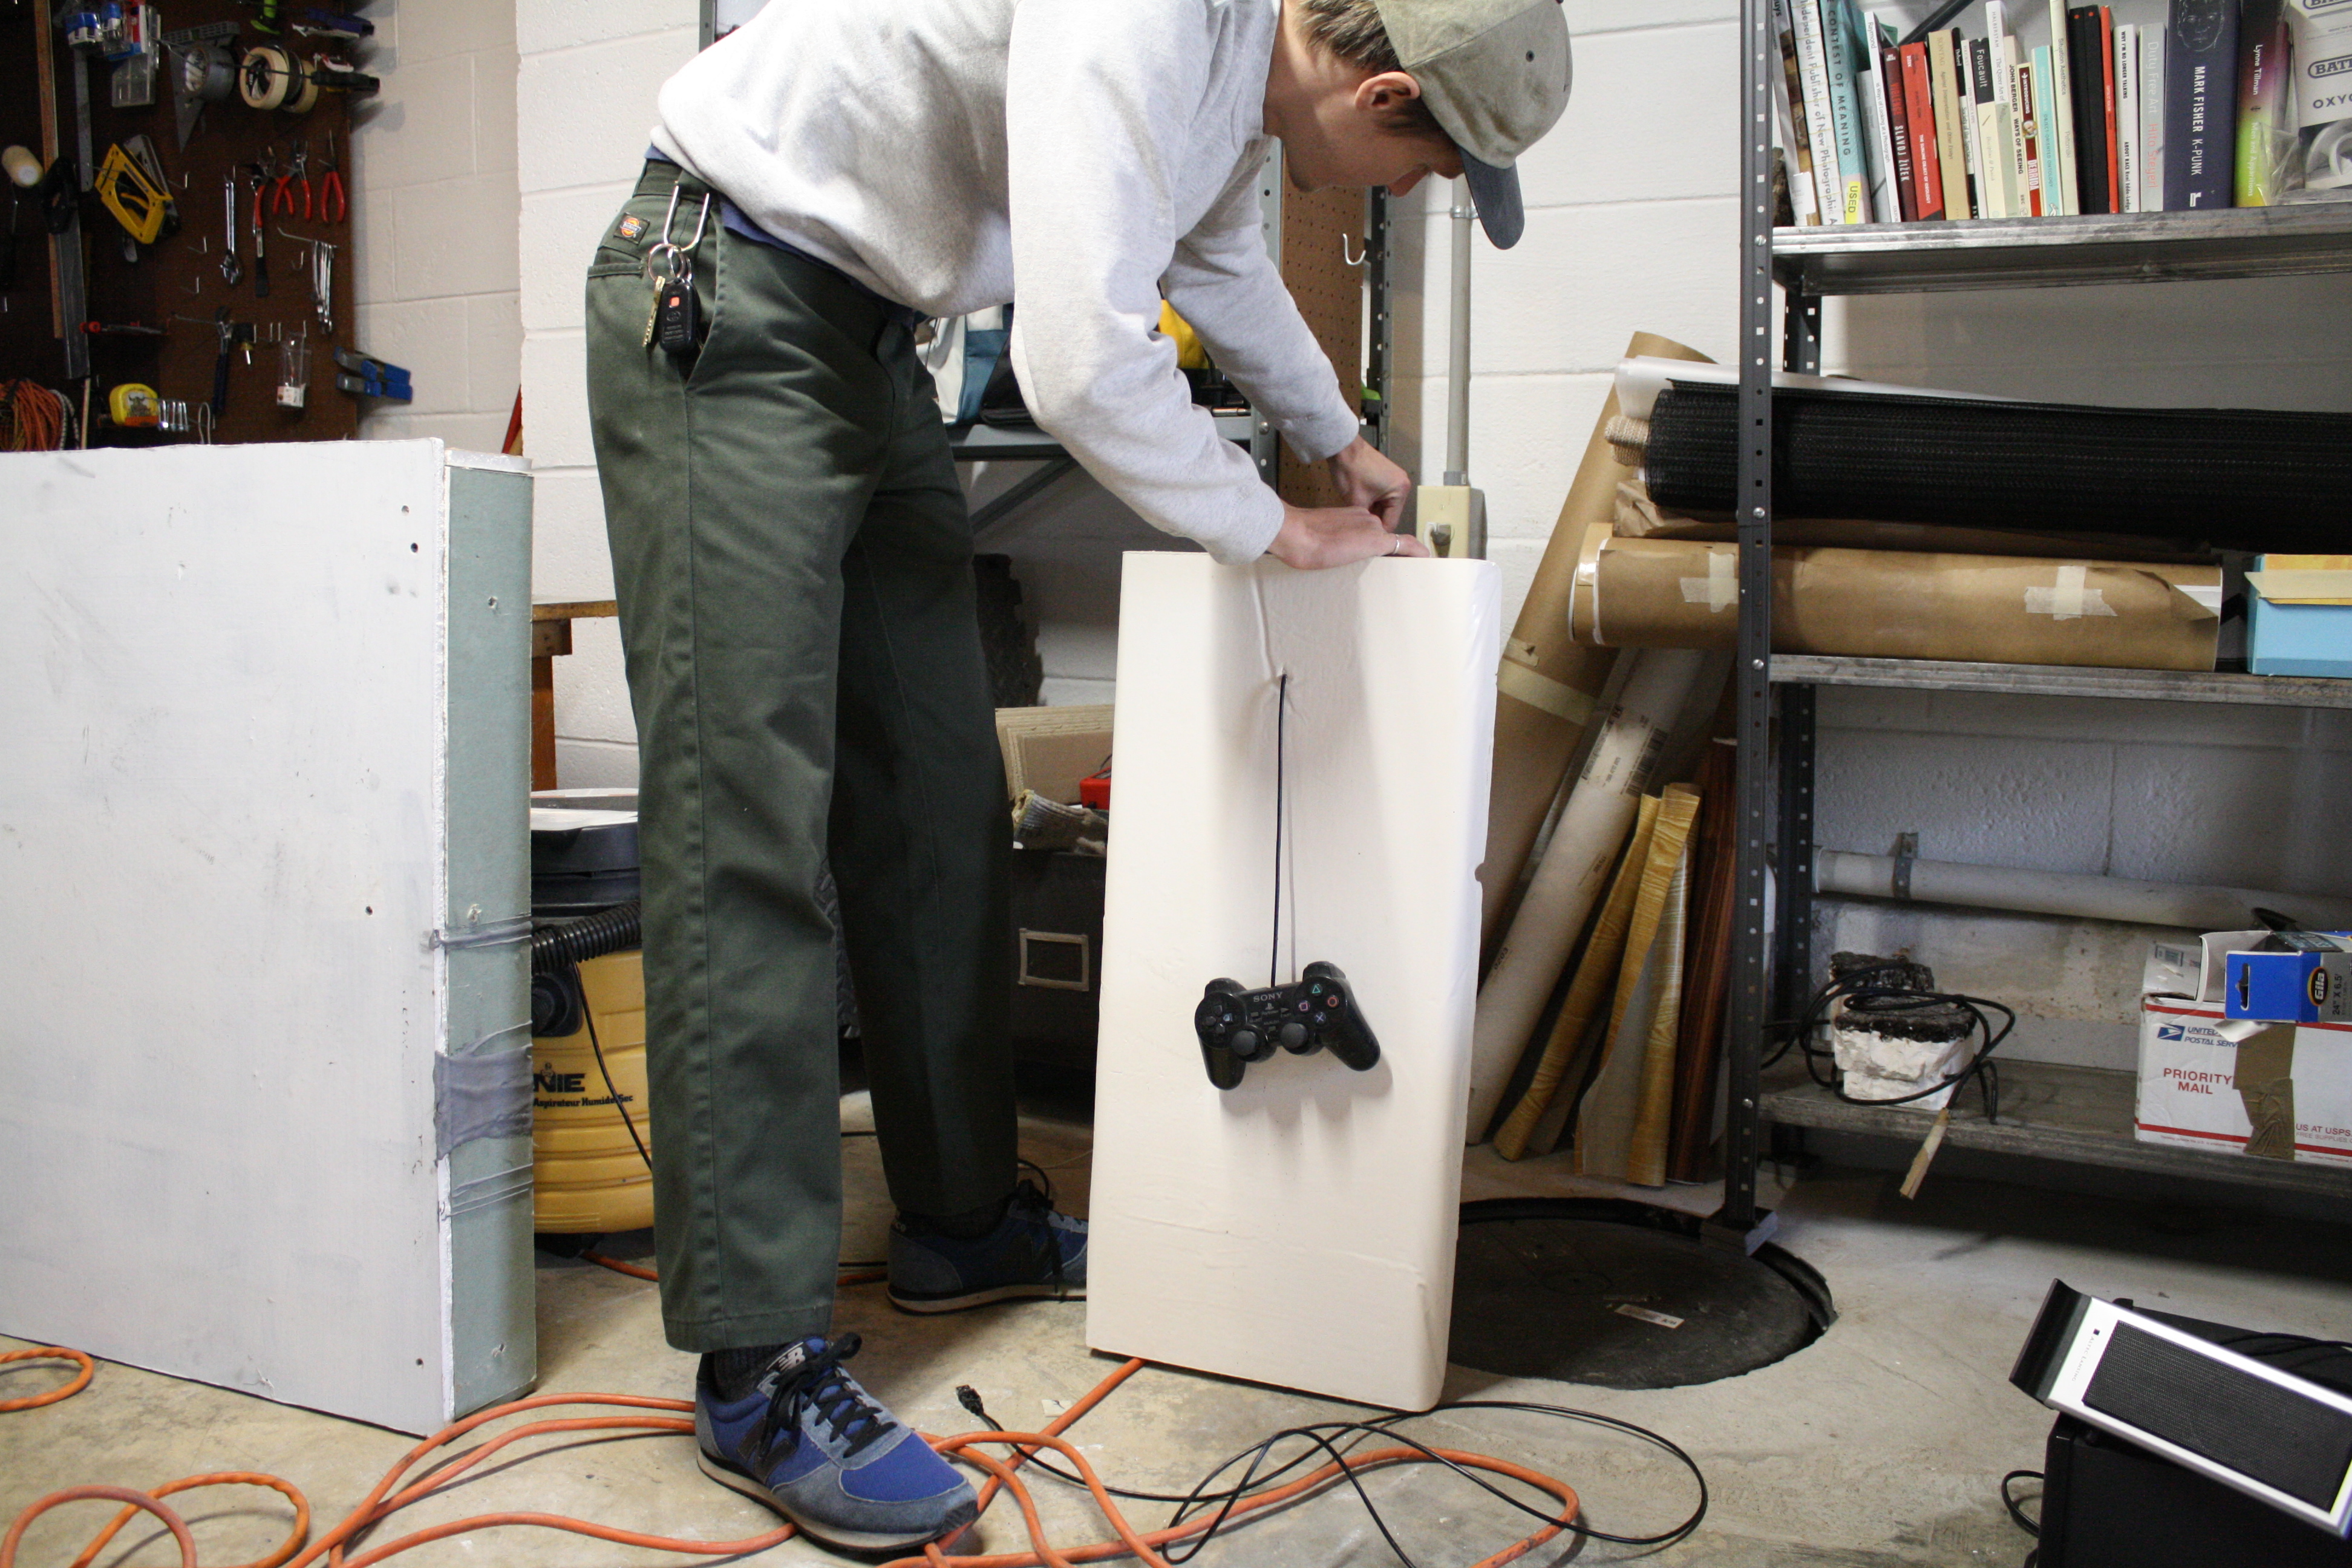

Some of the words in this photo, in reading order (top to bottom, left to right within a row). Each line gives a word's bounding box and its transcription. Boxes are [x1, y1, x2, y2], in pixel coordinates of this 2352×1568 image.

[1828, 10, 1841, 65] CONTEST
[1991, 11, 2000, 48] HALBERSTAM
[2145, 42, 2159, 69] Duty
[2253, 45, 2263, 67] Lynne
[1835, 73, 1844, 88] OF
[1976, 49, 1988, 88] Foucault
[2193, 67, 2206, 94] MARK
[1867, 22, 1877, 49] Raymond
[1882, 136, 1890, 163] Photograph
[2148, 73, 2159, 95] Free
[2252, 68, 2262, 96] Tillman
[1890, 82, 1903, 116] VIOLENCE
[2148, 99, 2158, 114] Art
[1815, 111, 1825, 121] of
[1838, 96, 1851, 156] MEANING
[2192, 97, 2205, 132] FISHER
[1817, 124, 1826, 146] New
[1895, 125, 1907, 155] SLAVOJ
[2016, 138, 2021, 147] OF
[2148, 123, 2159, 146] Hito
[2250, 122, 2259, 139] Men
[2190, 139, 2204, 175] K-PUNK
[2249, 141, 2258, 154] and
[1898, 158, 1910, 181] ŽIŽEK
[2027, 159, 2039, 191] DERRIDA
[2145, 150, 2159, 188] Steyerl
[2247, 156, 2258, 197] Apparitions
[1848, 185, 1858, 213] USED
[1253, 991, 1283, 1002] SONY
[2314, 973, 2325, 1000] Gila
[2184, 1036, 2215, 1046] POSTAL
[2163, 1068, 2233, 1085] PRIORITY
[2178, 1082, 2213, 1095] MAIL
[2314, 1134, 2348, 1143] SUPPLIES
[2084, 1336, 2095, 1354] ALTEC
